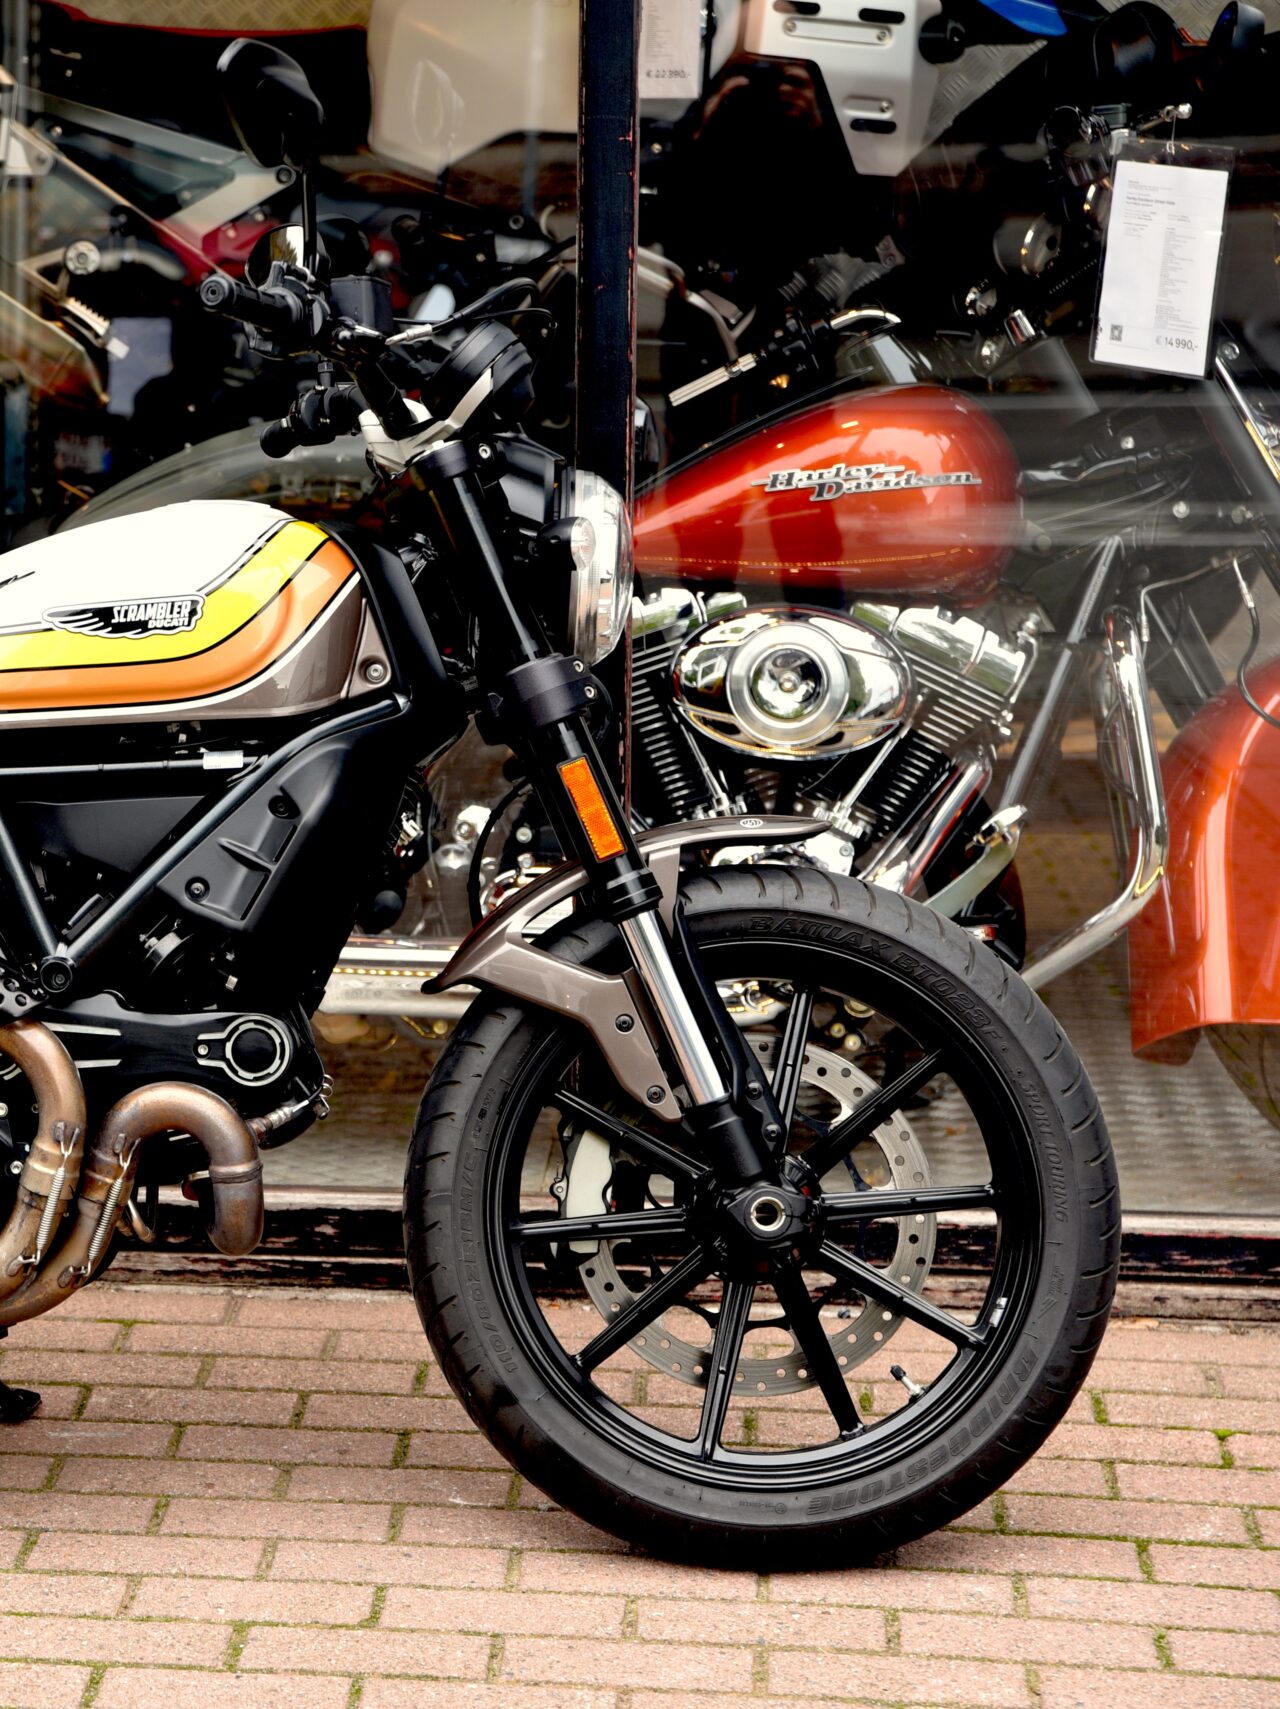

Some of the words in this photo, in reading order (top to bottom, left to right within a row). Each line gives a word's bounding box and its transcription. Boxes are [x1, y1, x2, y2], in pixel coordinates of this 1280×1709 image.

[763, 463, 888, 491] Harley
[809, 471, 979, 501] Davidson
[111, 600, 192, 624] SCRAMBLER
[147, 617, 189, 629] DUCATI
[749, 916, 890, 960] BATTLAX
[806, 1345, 1039, 1515] BRIDGESTONE
